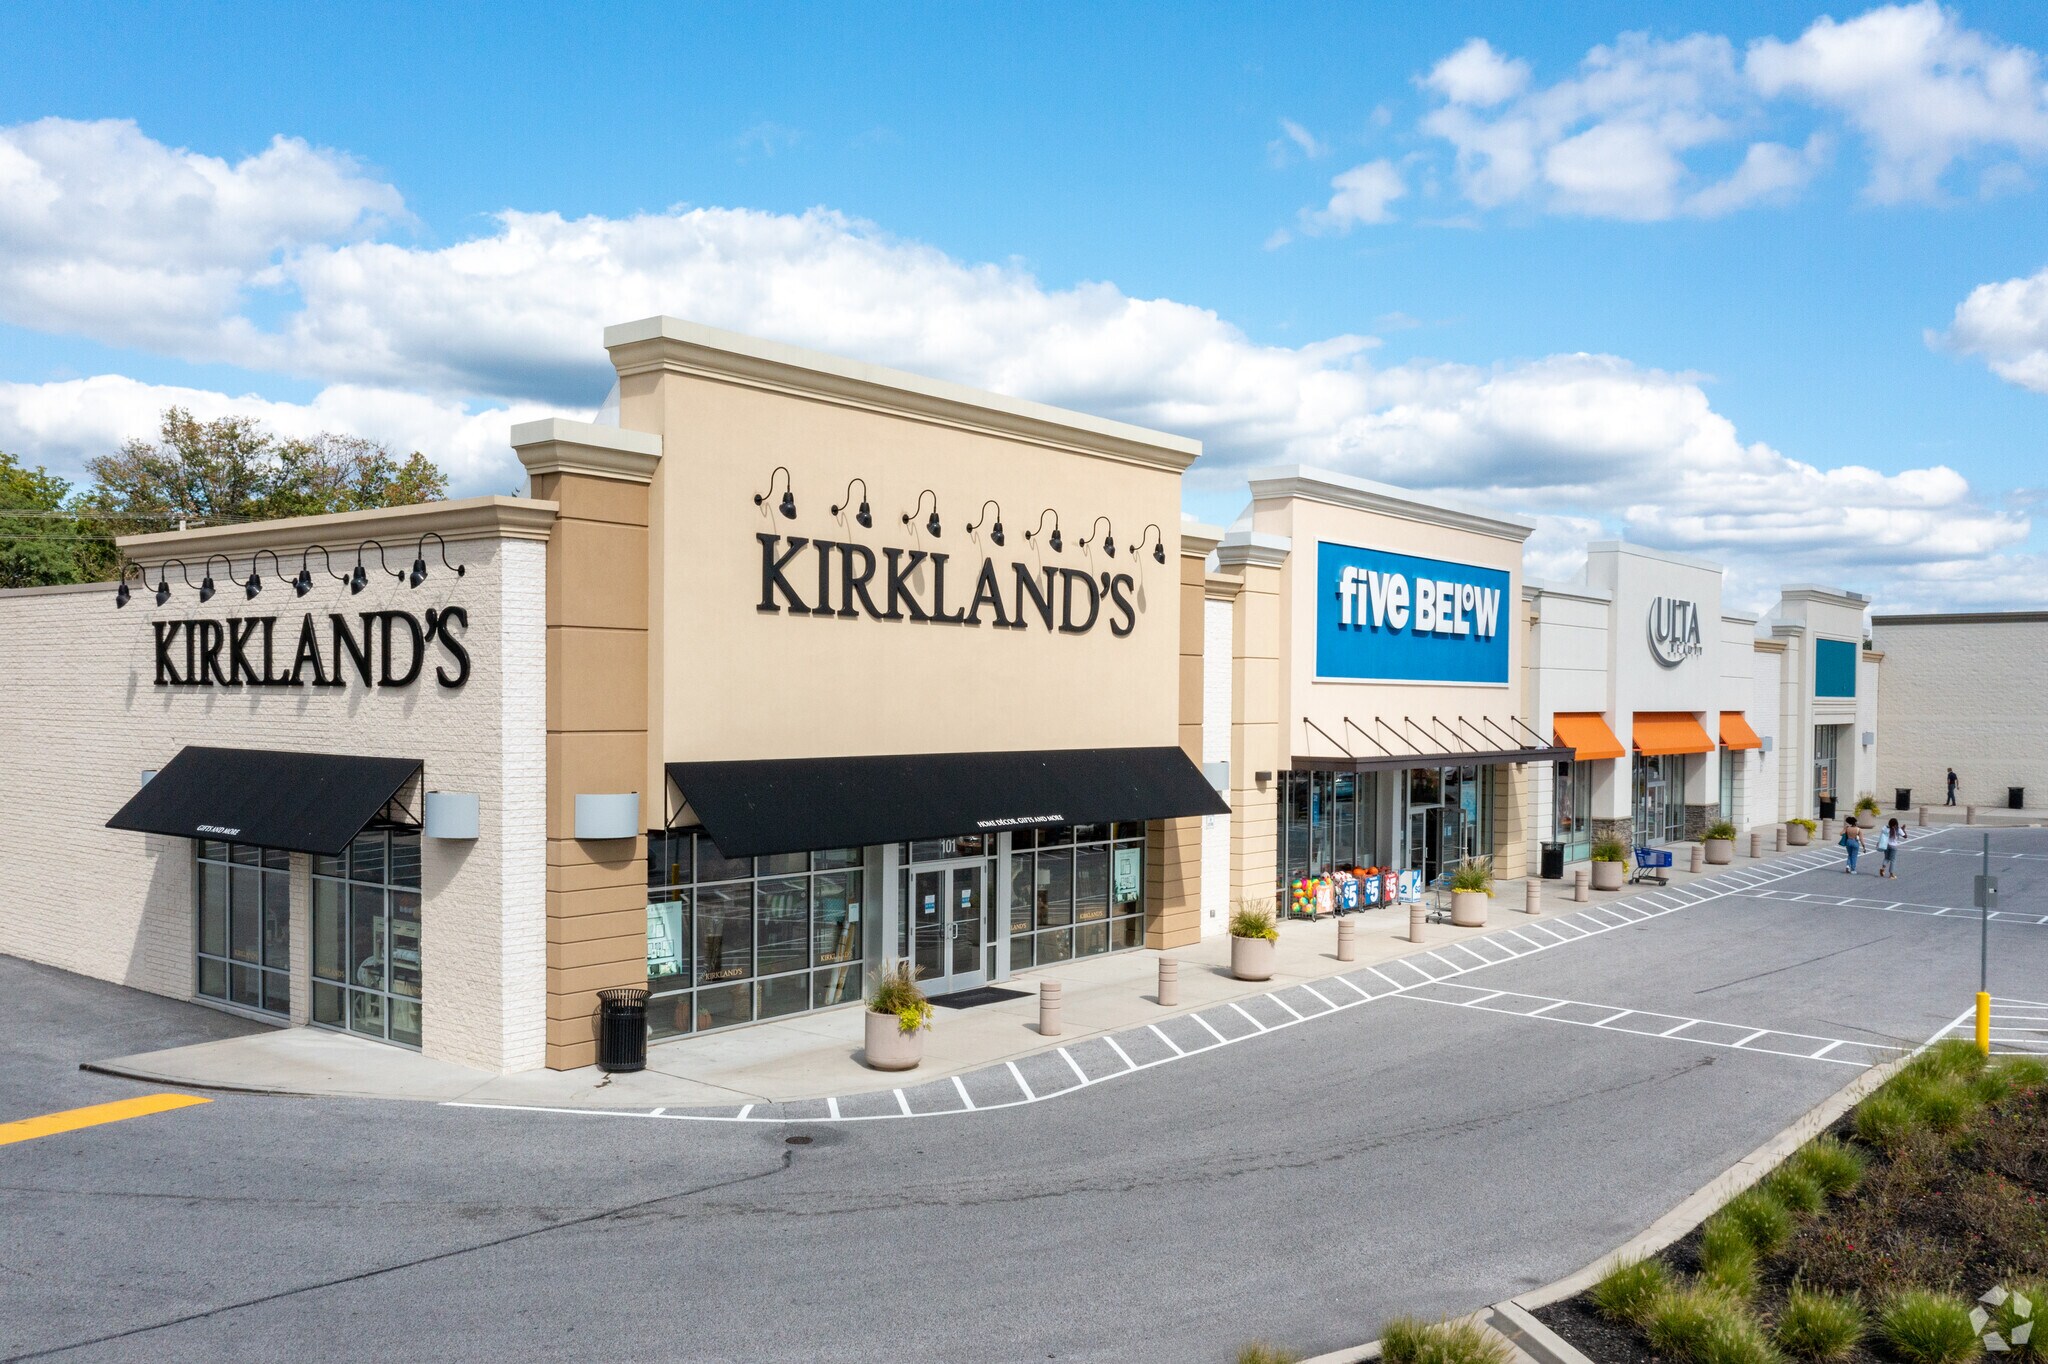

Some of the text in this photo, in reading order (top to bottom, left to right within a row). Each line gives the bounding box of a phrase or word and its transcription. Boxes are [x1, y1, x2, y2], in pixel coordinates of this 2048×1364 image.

[756, 532, 1136, 637] KIRKLAND'S
[1340, 566, 1501, 637] five BELOW
[1656, 596, 1701, 644] ULTA
[152, 606, 470, 689] KIRKLAND'S
[197, 824, 241, 836] GIFTS AND MORE
[977, 820, 997, 828] HOME
[1017, 816, 1035, 824] GIFTS
[941, 839, 956, 853] 101
[1344, 884, 1357, 907] $5
[1366, 880, 1379, 902] $5
[1386, 877, 1396, 899] $5
[705, 967, 743, 980] KIRKLAND'S
